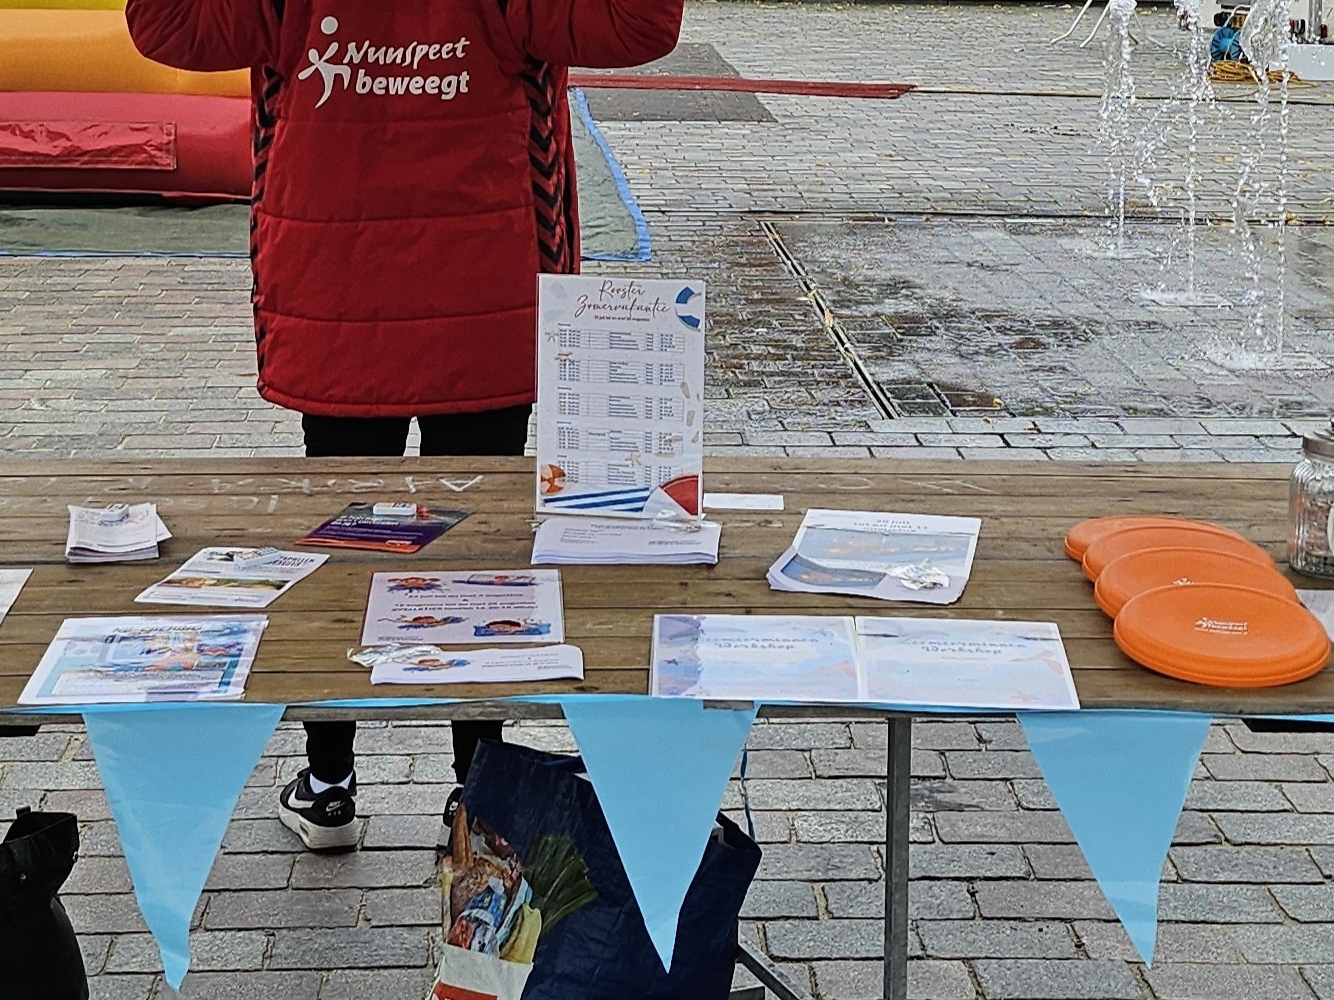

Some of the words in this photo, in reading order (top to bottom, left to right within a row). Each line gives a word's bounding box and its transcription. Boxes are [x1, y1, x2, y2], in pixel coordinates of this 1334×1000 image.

[343, 37, 470, 69] Nunspeet
[356, 69, 470, 100] beweegt
[598, 279, 646, 302] Rooster
[574, 295, 671, 319] Zomervakantie
